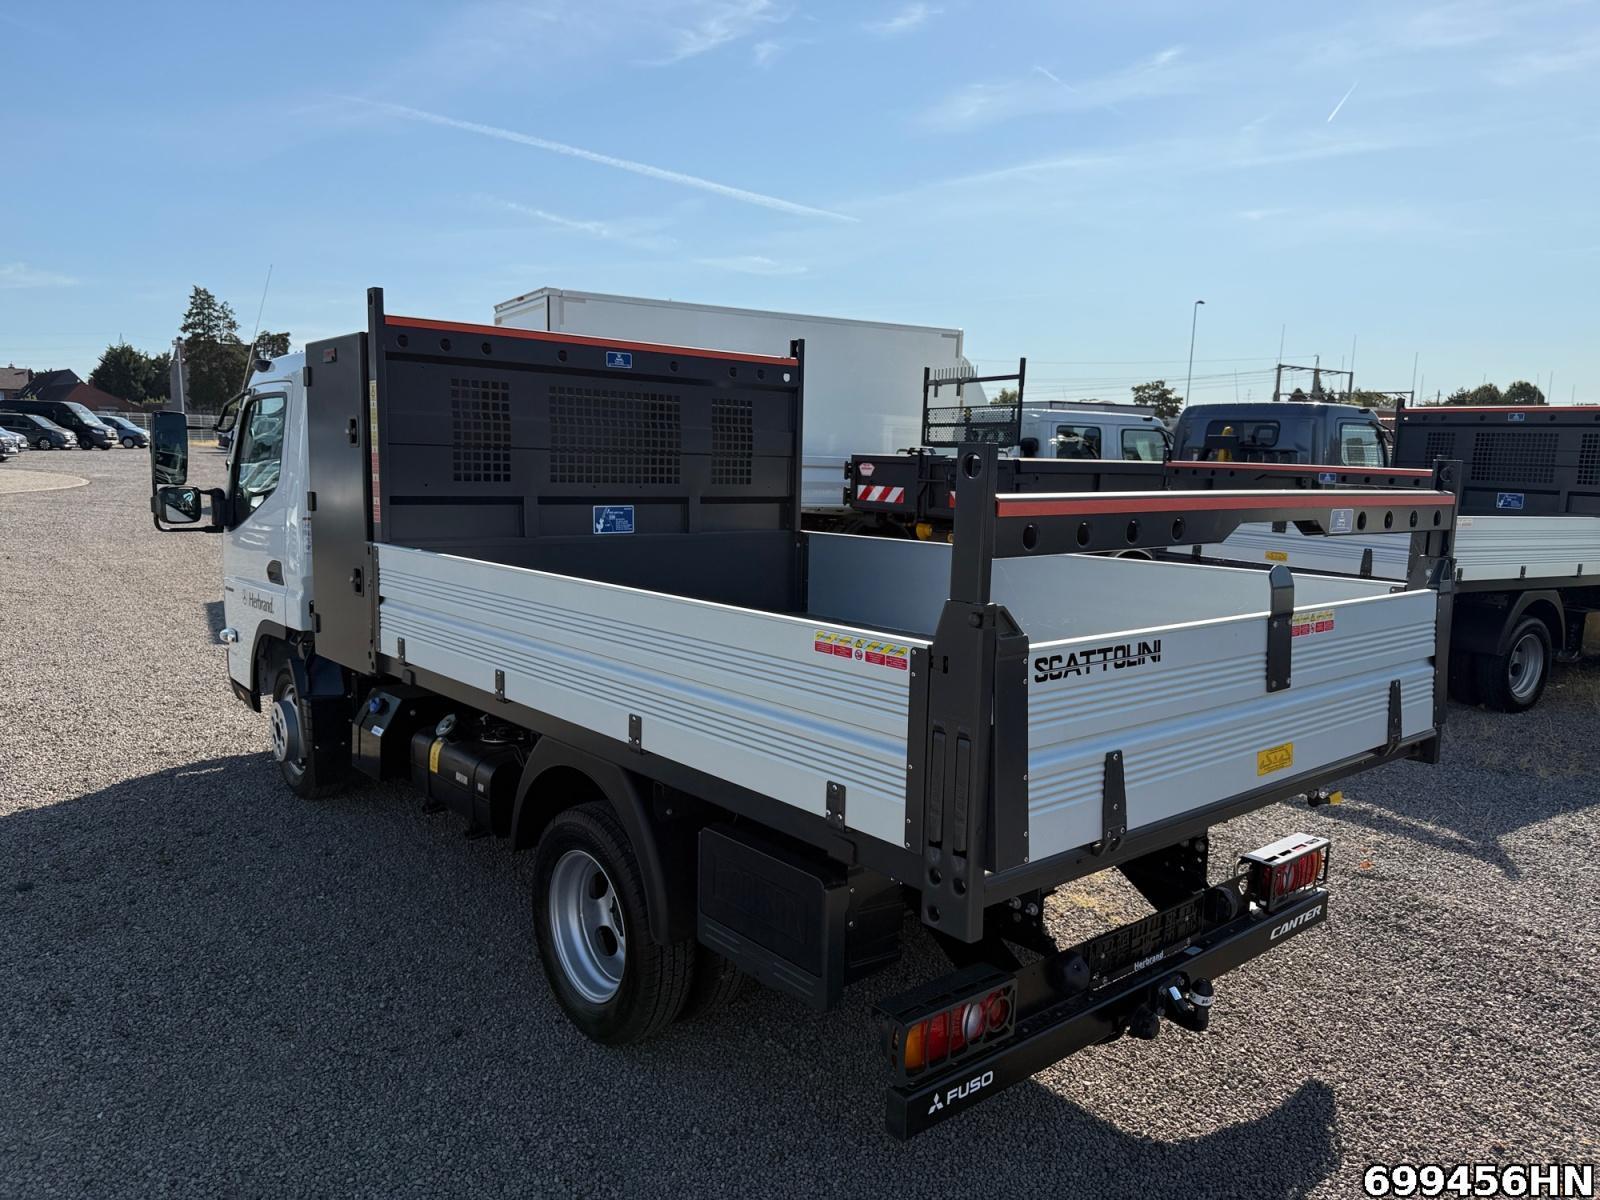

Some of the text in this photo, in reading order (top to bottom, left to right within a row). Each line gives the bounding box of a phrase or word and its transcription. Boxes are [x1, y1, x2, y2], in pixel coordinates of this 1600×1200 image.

[1034, 640, 1161, 683] SCATTOLINI
[1270, 905, 1322, 940] CANTER
[946, 1071, 993, 1105] FUSO
